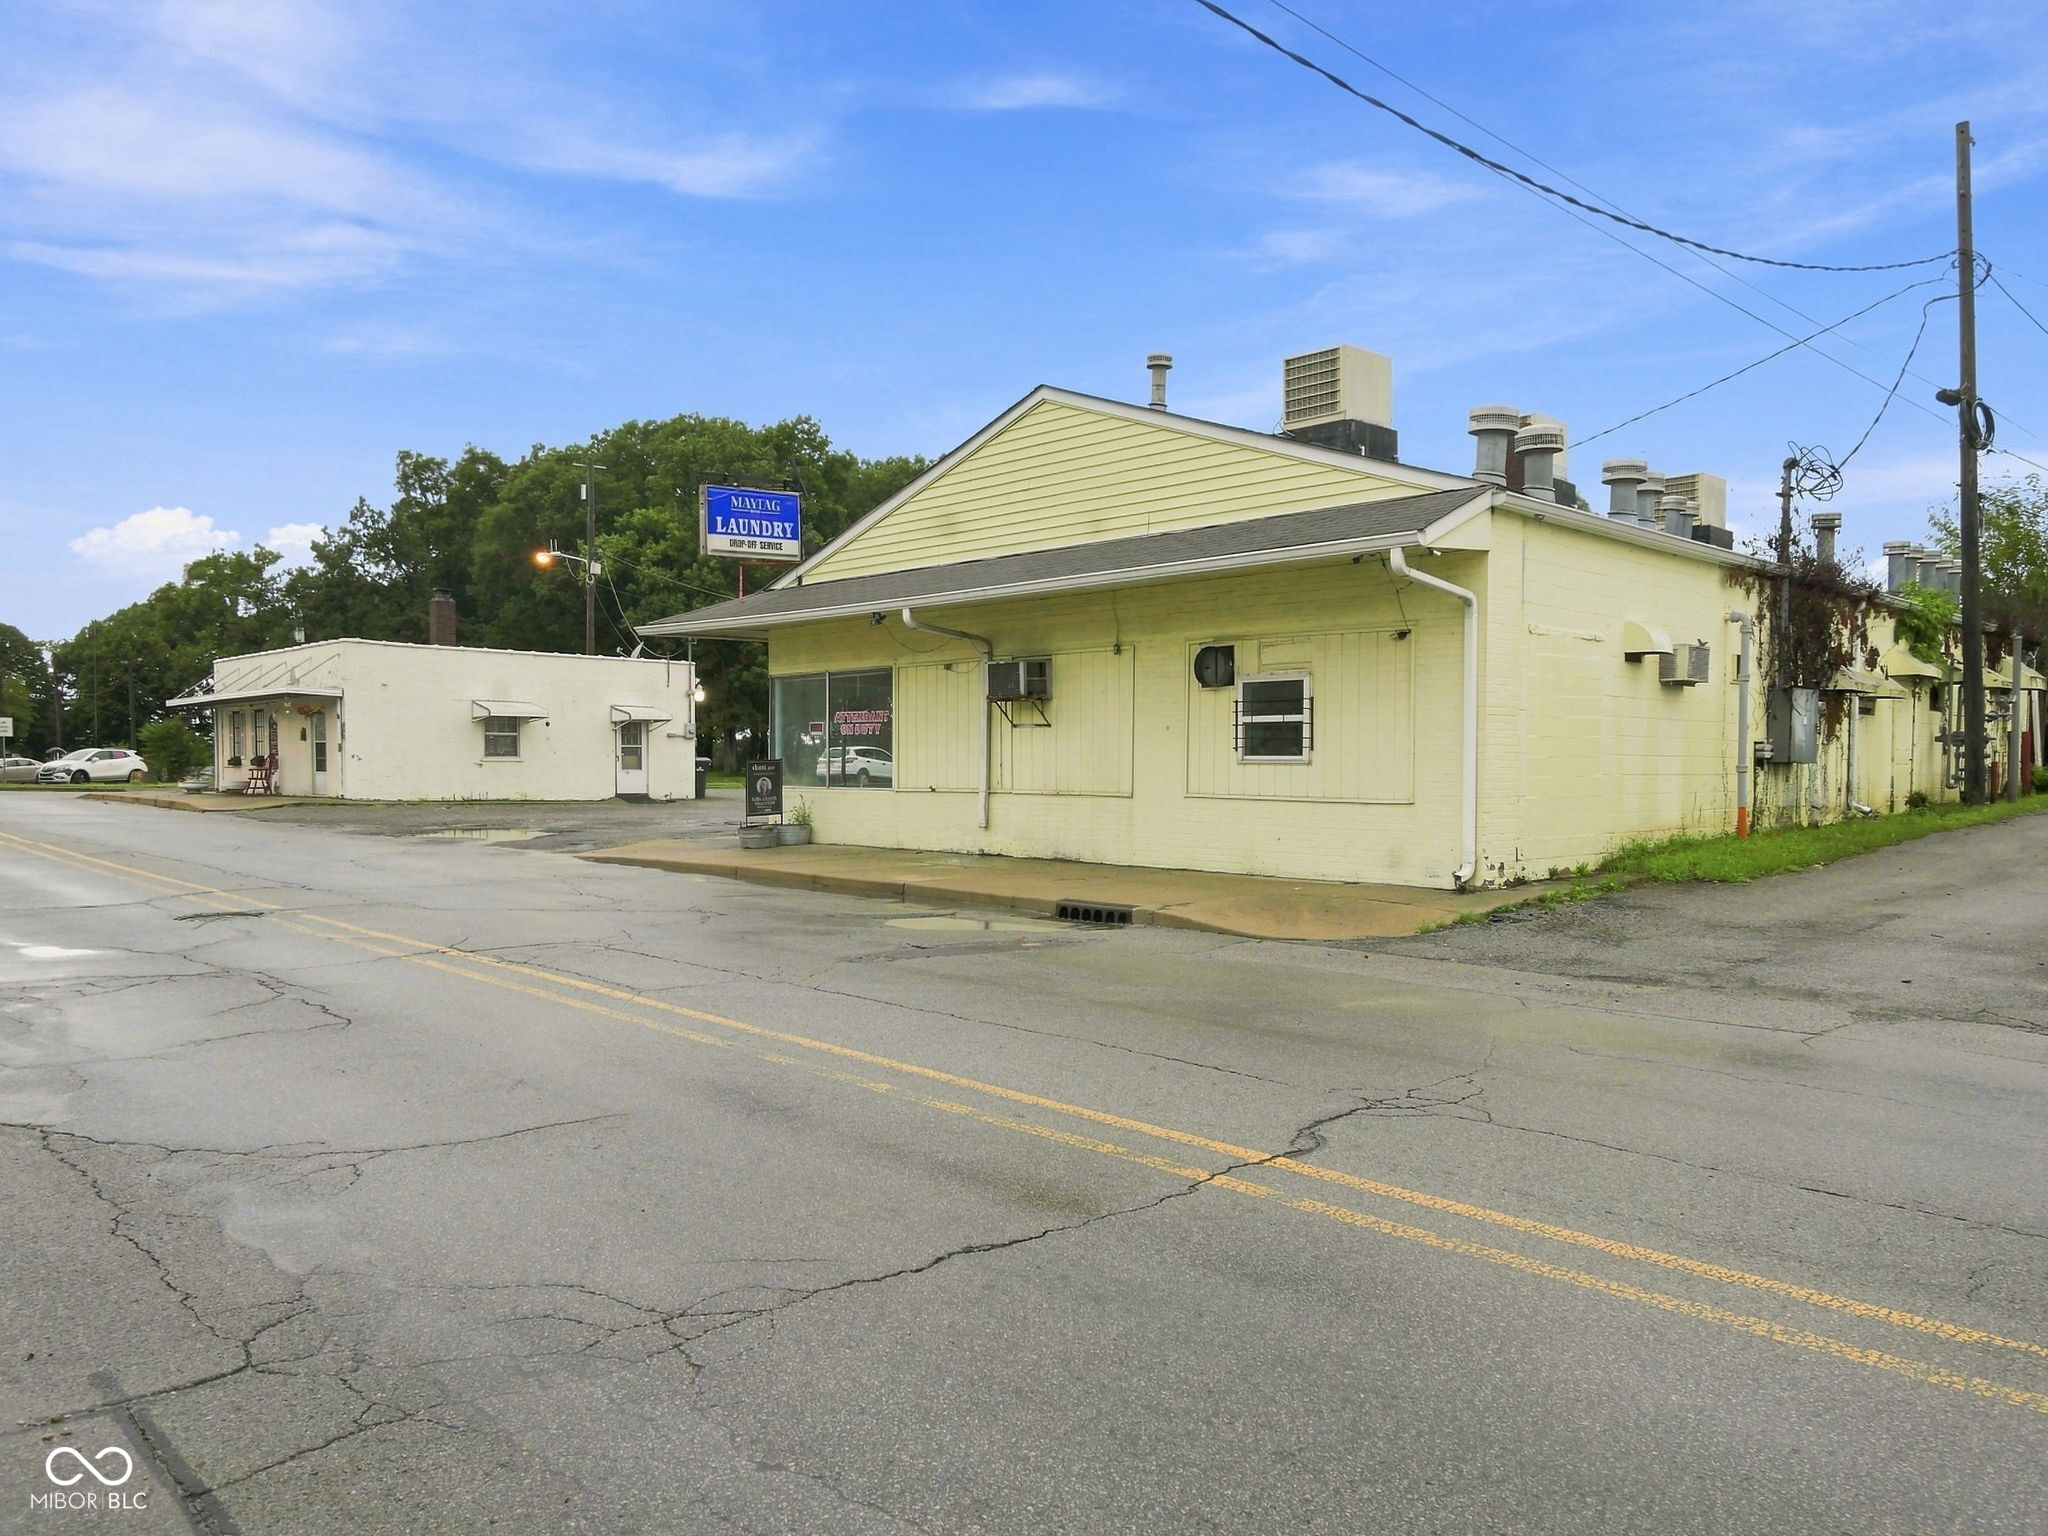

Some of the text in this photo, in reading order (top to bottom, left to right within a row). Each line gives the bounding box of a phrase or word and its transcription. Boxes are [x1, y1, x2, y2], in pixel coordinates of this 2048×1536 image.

[731, 495, 780, 511] MAYTAG
[715, 516, 794, 538] LAUNDRY
[729, 539, 783, 551] DROP-OFF SERVICE
[834, 711, 889, 723] ATTENDANT
[840, 723, 881, 735] ON DUTY
